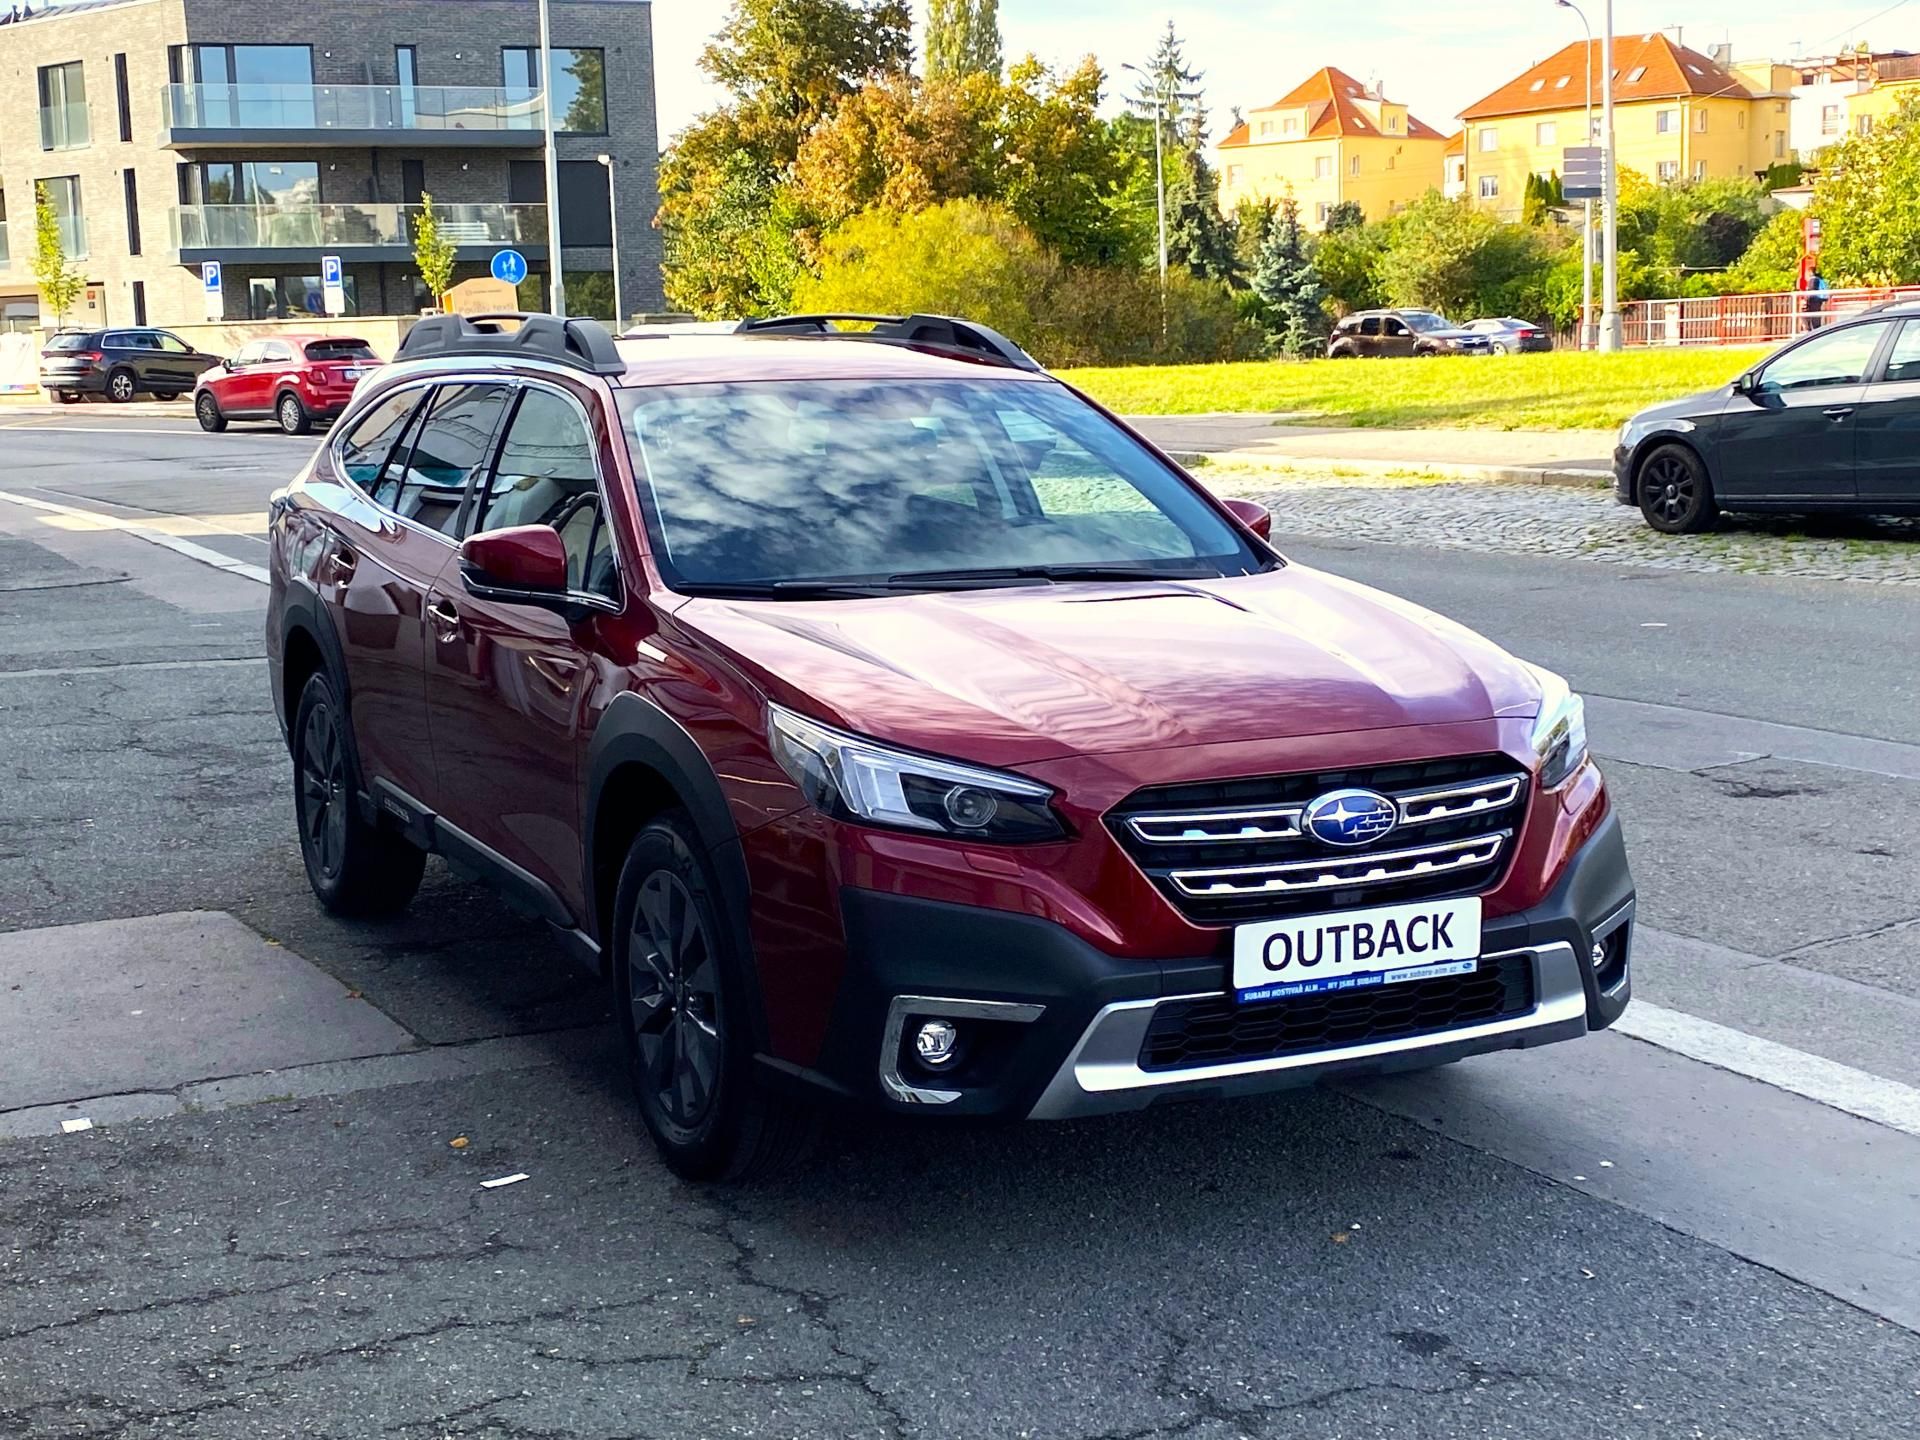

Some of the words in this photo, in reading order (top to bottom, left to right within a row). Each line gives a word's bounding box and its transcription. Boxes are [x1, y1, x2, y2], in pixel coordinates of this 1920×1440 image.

[207, 267, 217, 285] P
[327, 260, 337, 280] P
[1262, 911, 1454, 972] OUTBACK
[1244, 990, 1270, 1001] SUBARU
[1357, 975, 1382, 986] SUBARU
